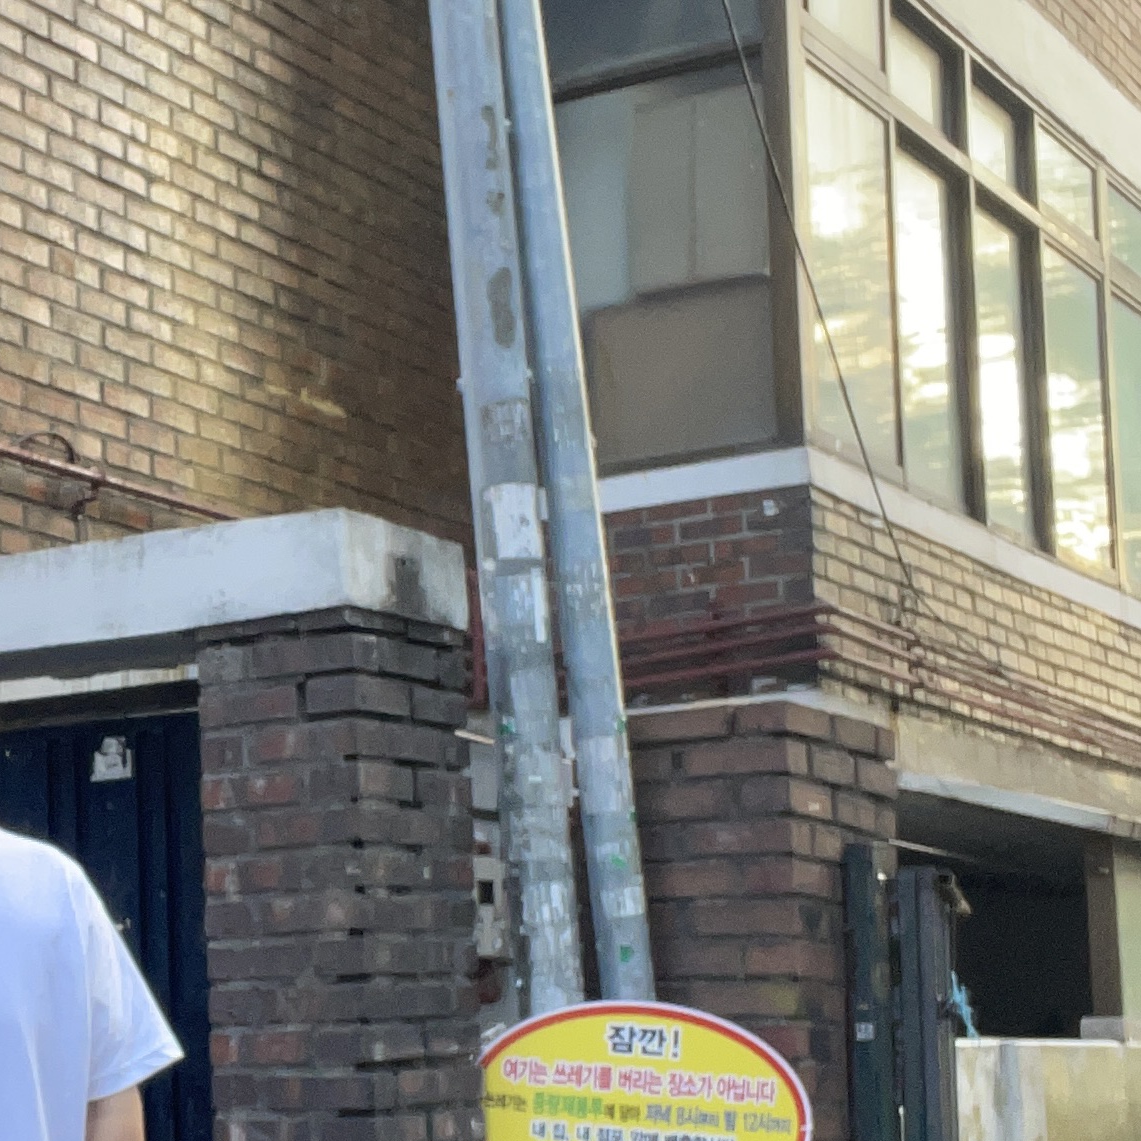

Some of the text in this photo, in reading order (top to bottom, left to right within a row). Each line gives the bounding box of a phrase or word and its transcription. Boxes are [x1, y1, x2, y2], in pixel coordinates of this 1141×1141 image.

[608, 1024, 680, 1058] 잠깐!
[503, 1058, 775, 1104] 여기는 쓰레기를 버리는 장소가 아닙니다
